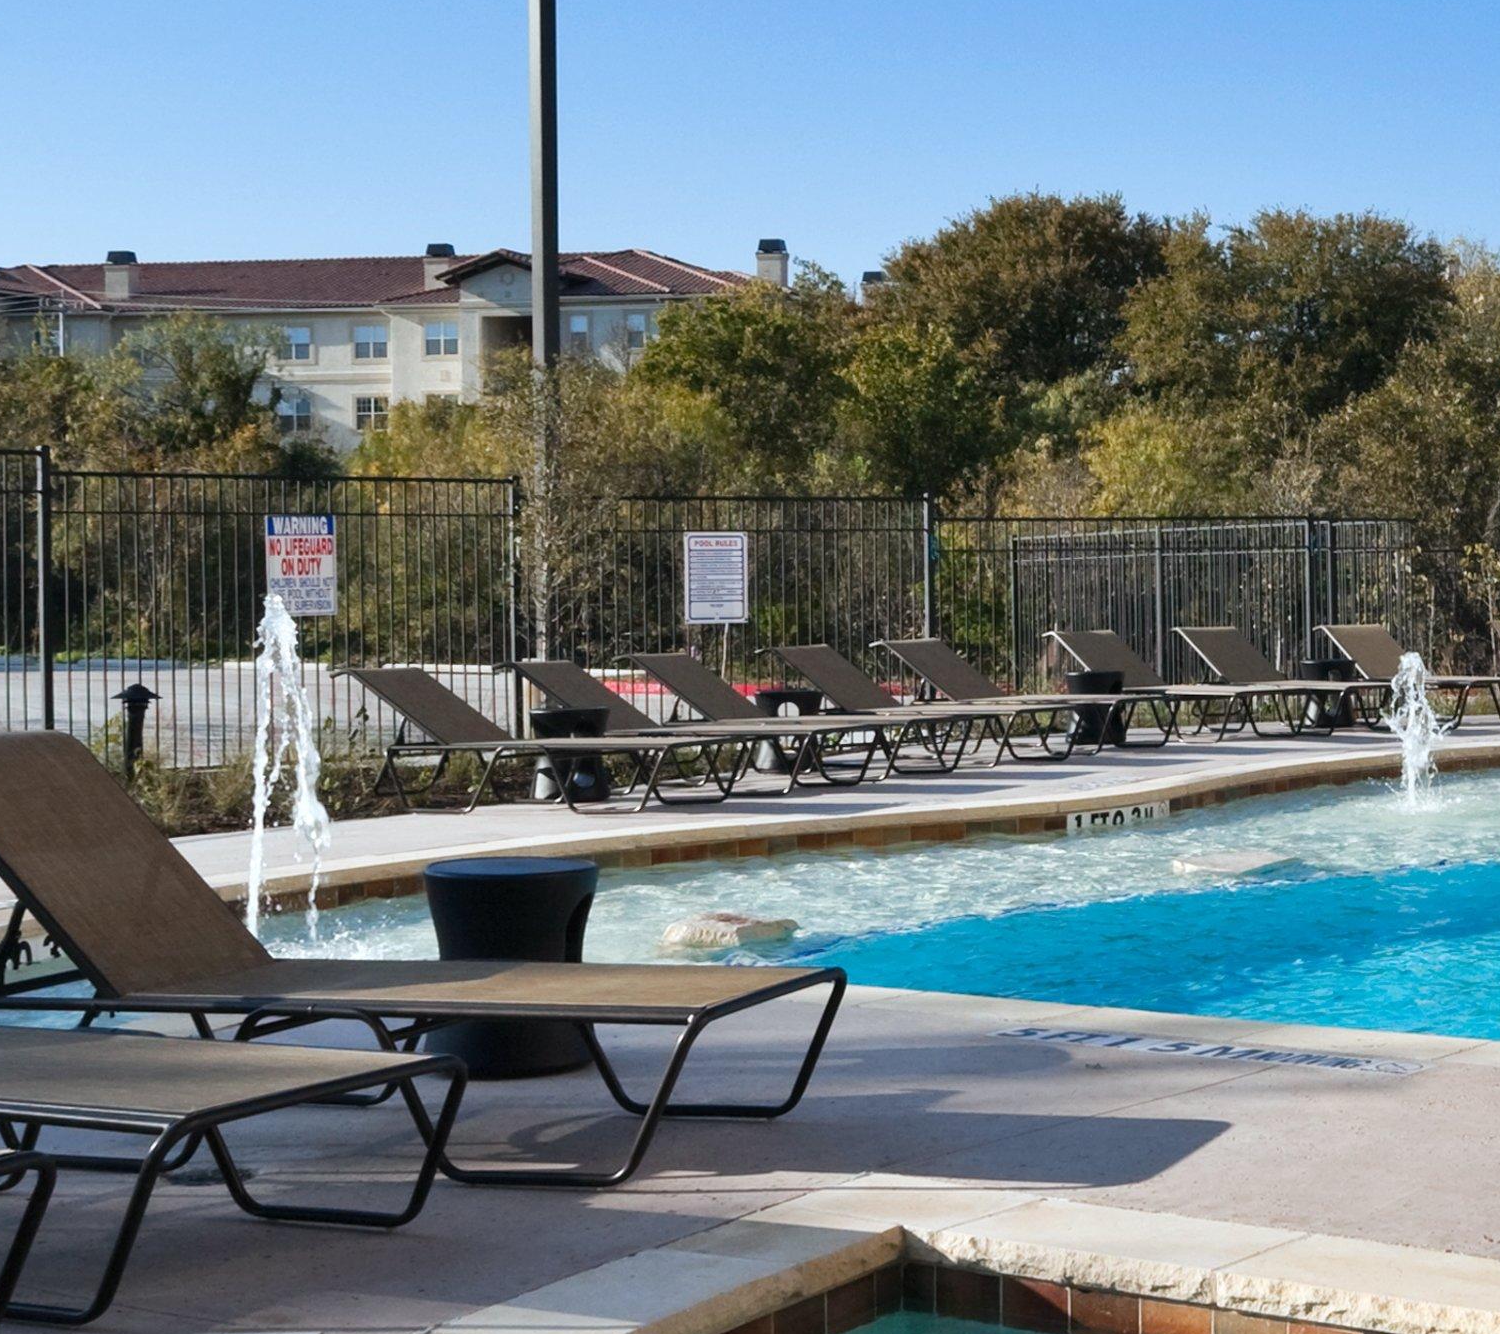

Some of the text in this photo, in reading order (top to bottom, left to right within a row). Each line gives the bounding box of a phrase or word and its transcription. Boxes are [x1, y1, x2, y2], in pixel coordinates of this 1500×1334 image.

[273, 516, 327, 534] WARNING
[269, 537, 334, 556] NO LIFEGUARD
[694, 539, 739, 547] POOL RULES
[282, 558, 322, 576] ON DUTY
[997, 1027, 1048, 1037] 5
[1195, 1046, 1264, 1059] M
